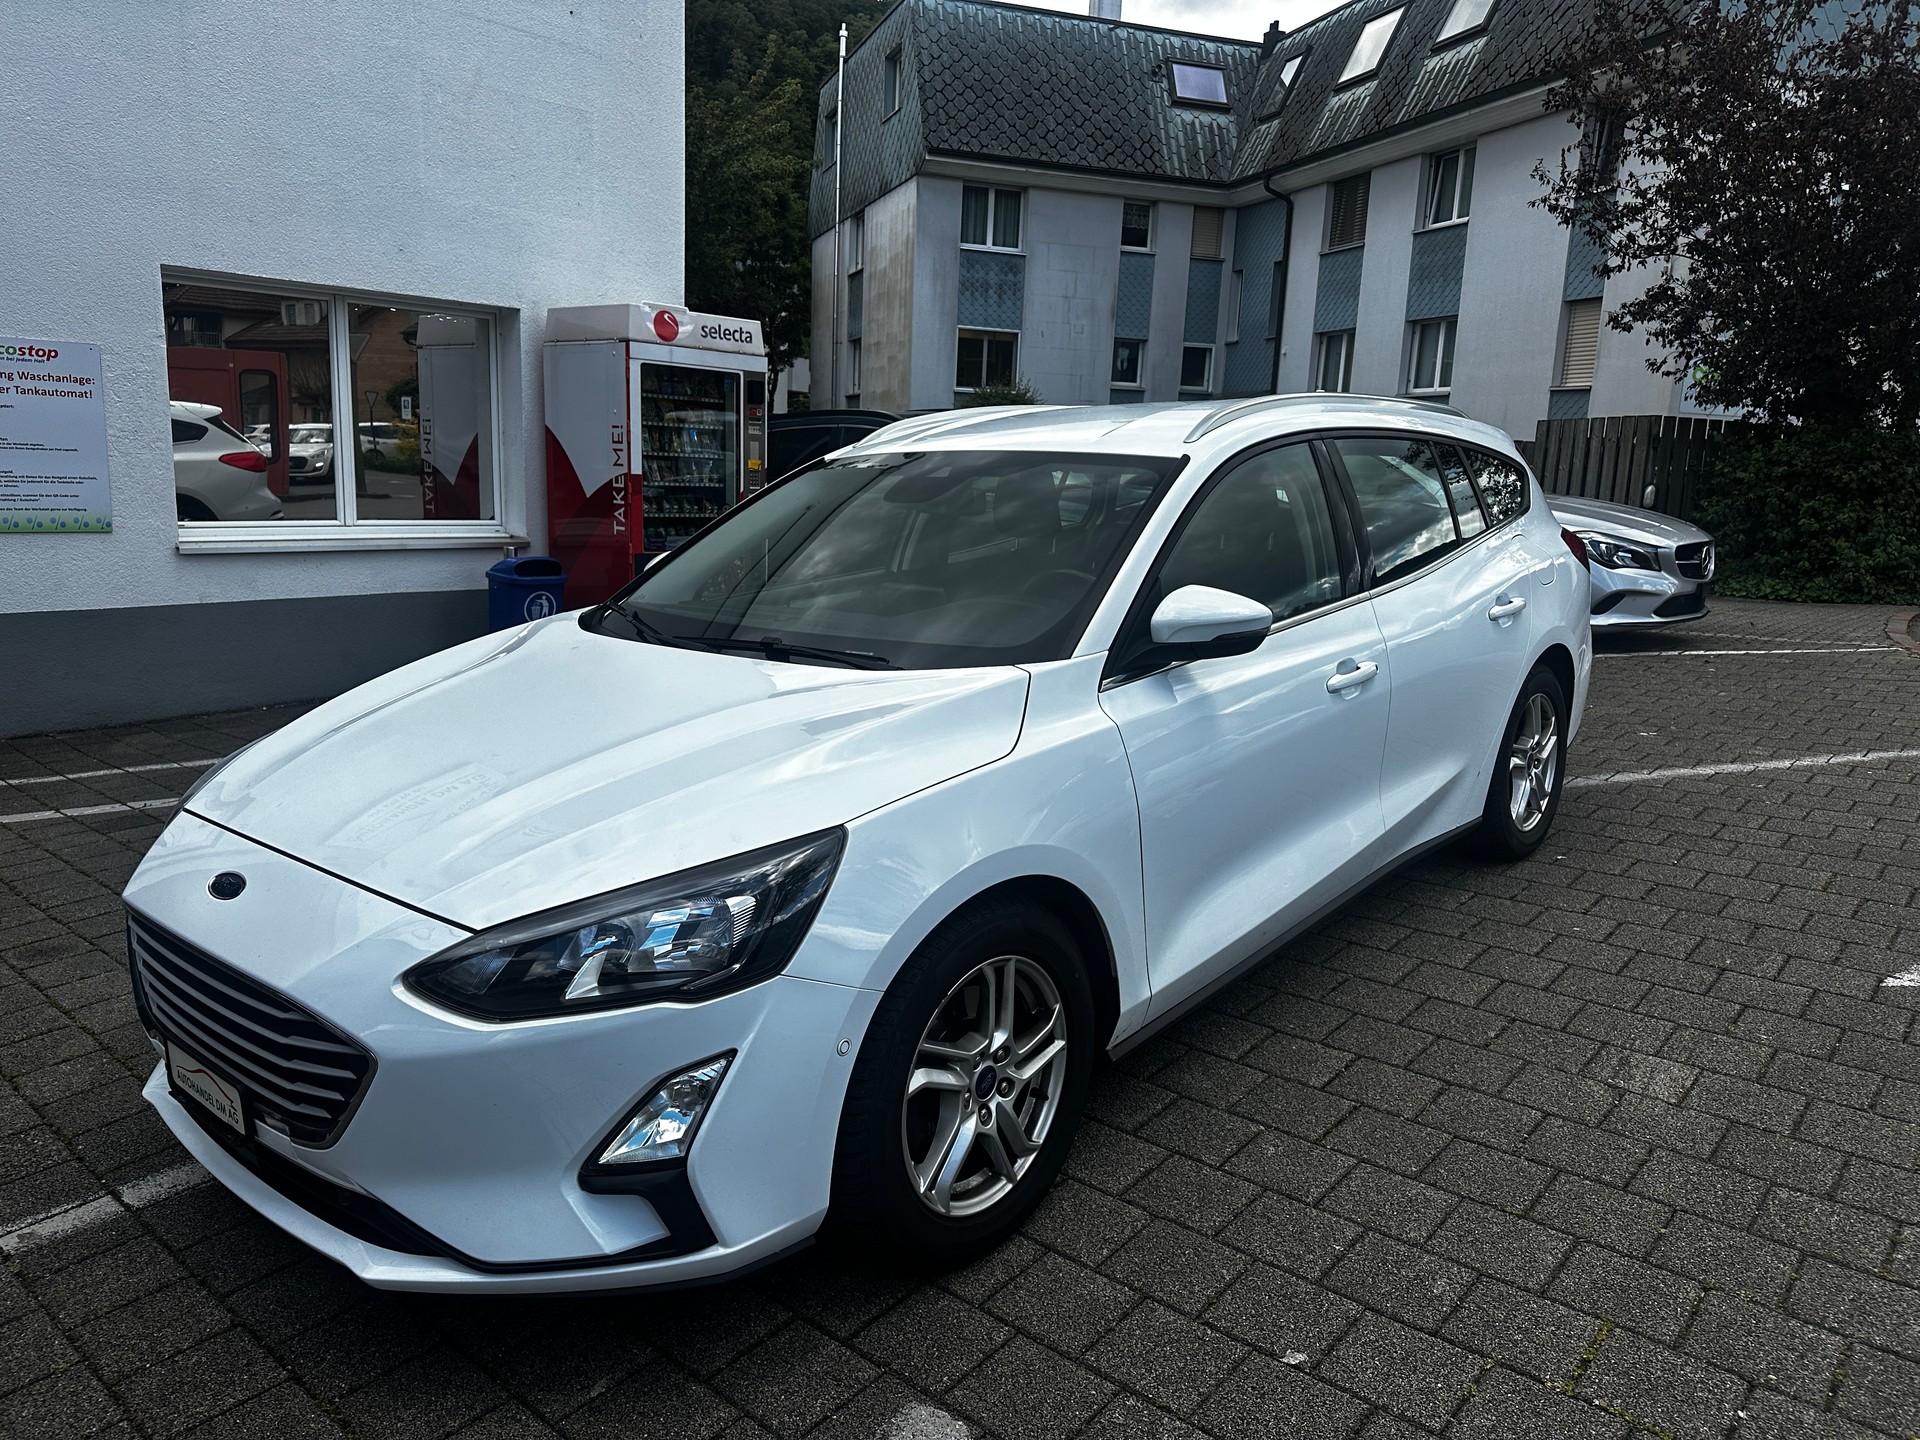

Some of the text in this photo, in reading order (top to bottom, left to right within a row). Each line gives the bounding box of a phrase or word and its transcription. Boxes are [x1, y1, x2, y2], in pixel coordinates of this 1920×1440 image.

[701, 324, 753, 344] selecta
[17, 371, 95, 386] Waschanlage:
[13, 386, 93, 399] Tankautomat!
[612, 425, 626, 535] TAKE ME!
[177, 1070, 239, 1124] AUTOHANDEL DM AG
